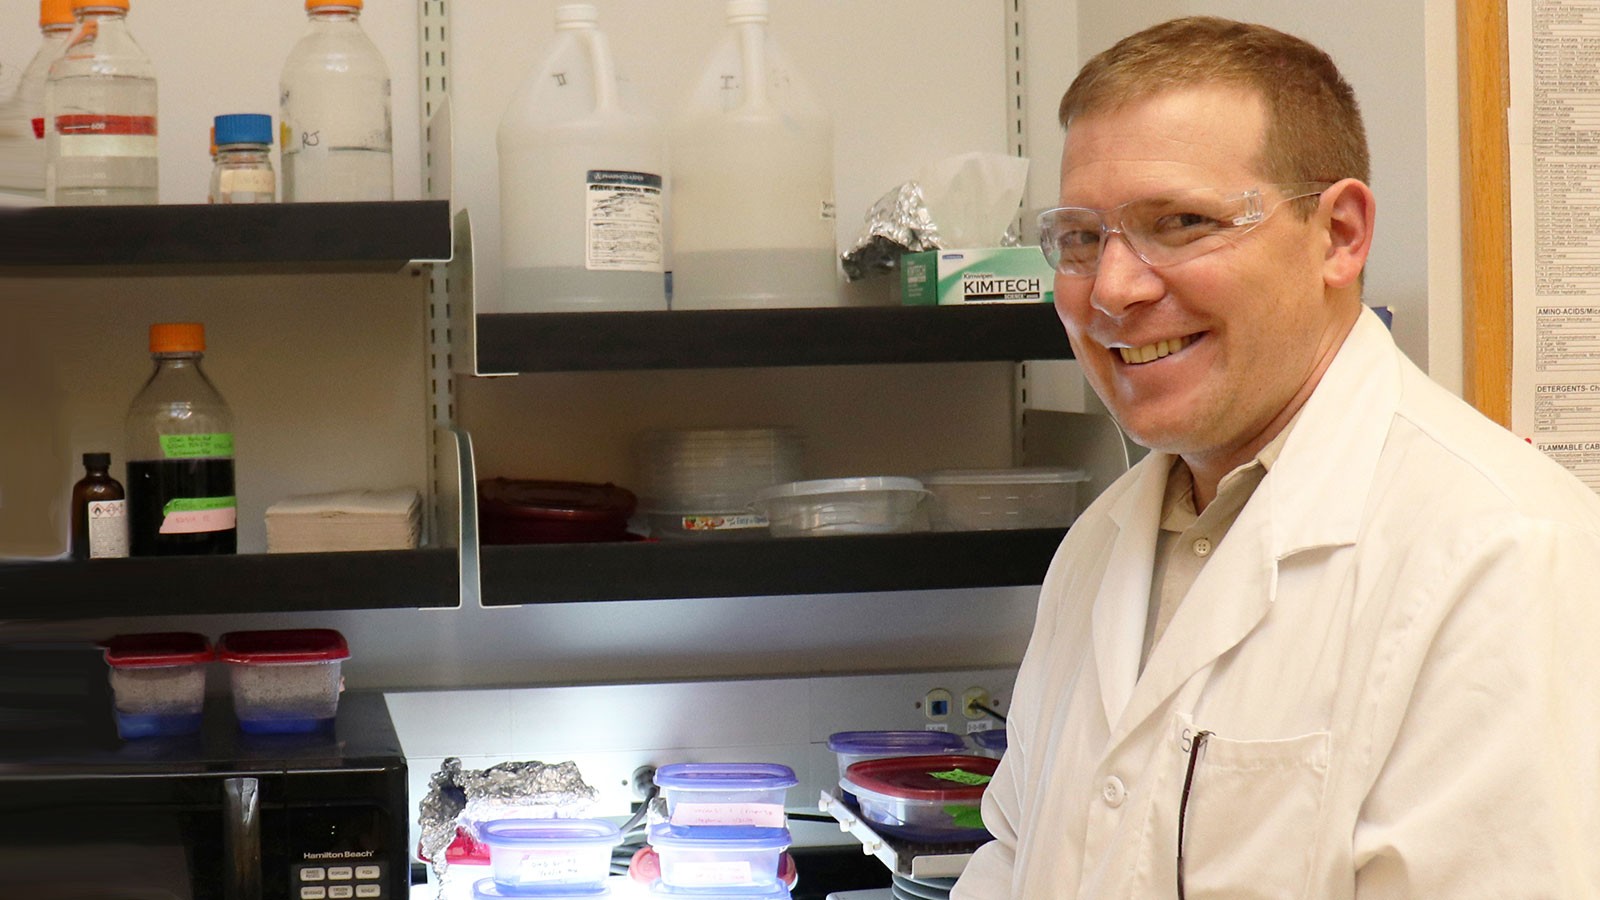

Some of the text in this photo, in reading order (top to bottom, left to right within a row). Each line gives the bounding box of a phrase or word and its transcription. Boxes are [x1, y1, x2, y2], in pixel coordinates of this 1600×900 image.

[964, 278, 1040, 294] KIMTECH
[303, 850, 372, 859] Hamilton Beach
